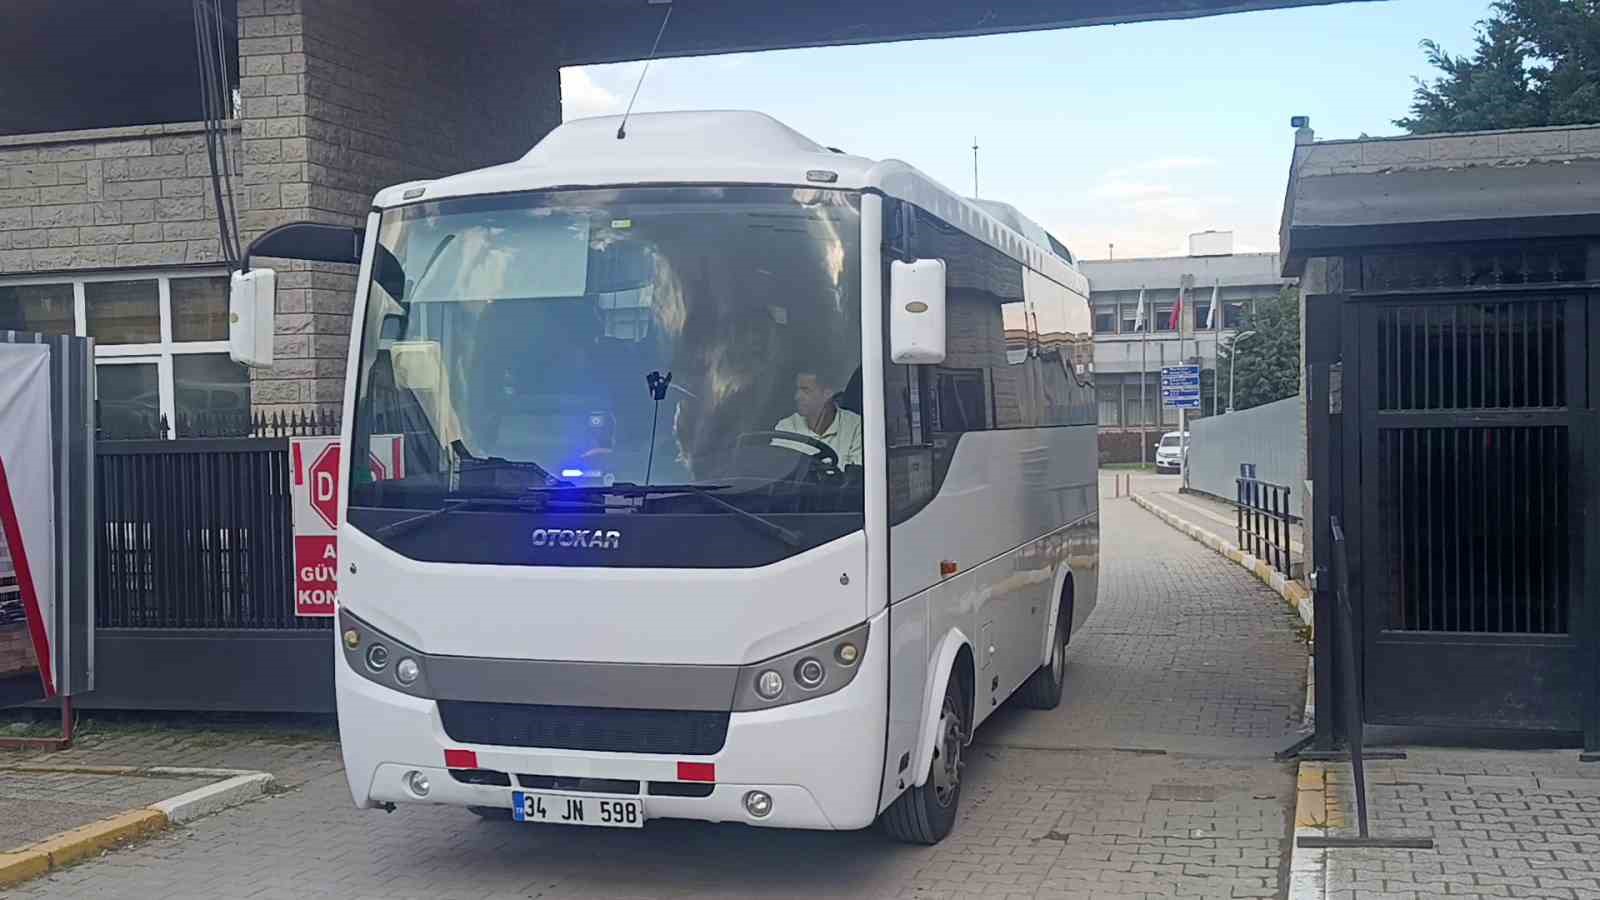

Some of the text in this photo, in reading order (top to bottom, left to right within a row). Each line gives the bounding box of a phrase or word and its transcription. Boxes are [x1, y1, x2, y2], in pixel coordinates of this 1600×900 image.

[532, 529, 621, 549] OTOKAR
[301, 563, 337, 582] GÜV
[298, 589, 337, 605] KON
[525, 796, 547, 818] 34
[561, 799, 584, 821] JN
[600, 801, 637, 824] 598
